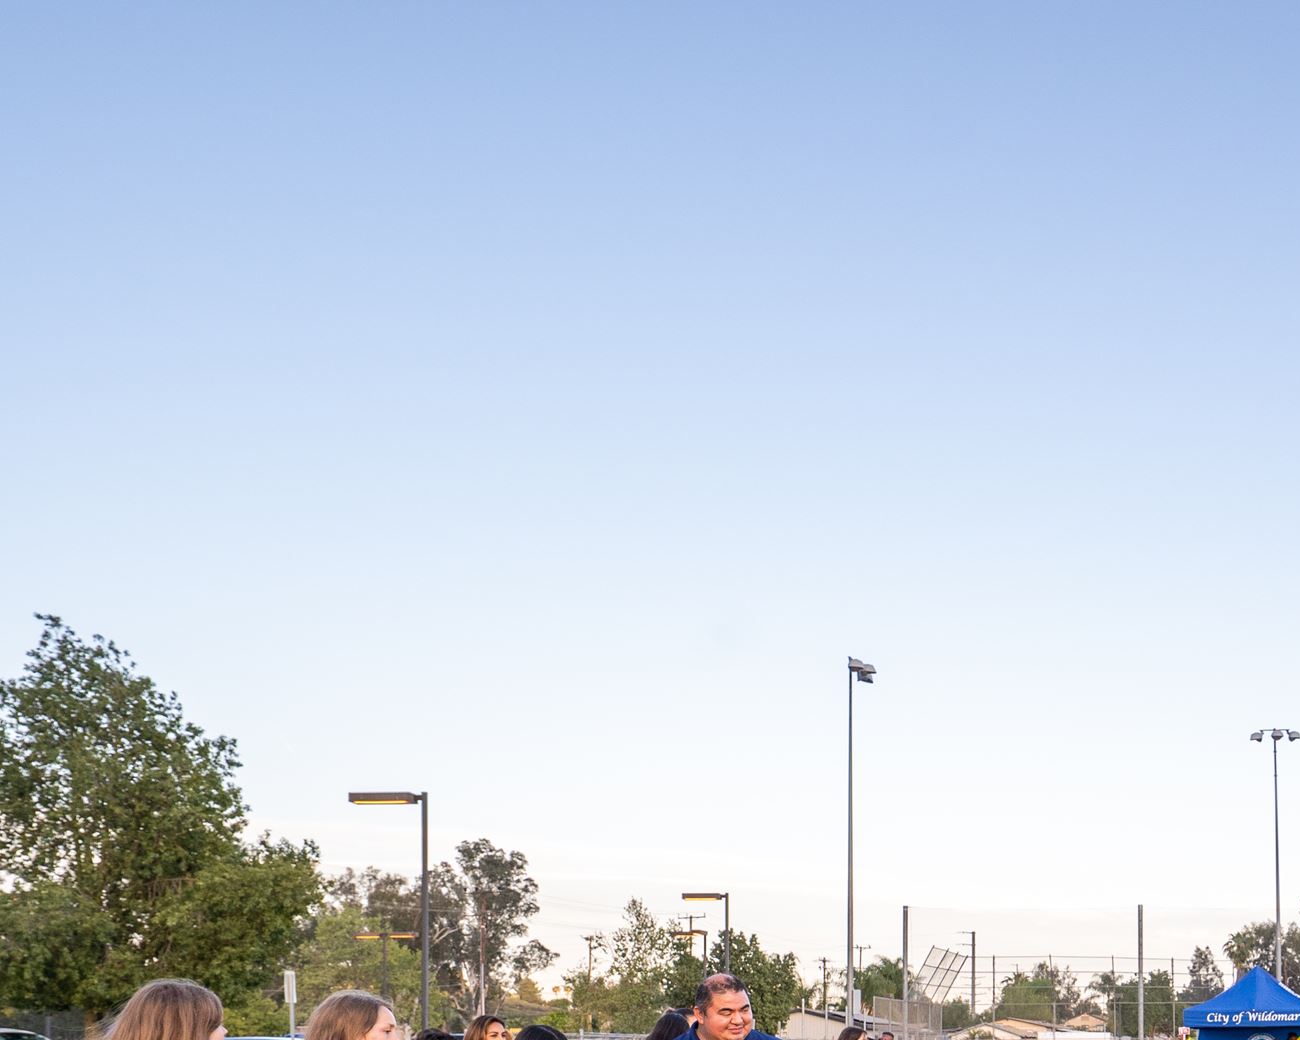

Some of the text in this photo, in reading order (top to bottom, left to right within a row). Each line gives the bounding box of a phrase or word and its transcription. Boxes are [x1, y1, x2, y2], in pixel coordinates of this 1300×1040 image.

[1207, 1009, 1300, 1025] City of Wildomar
